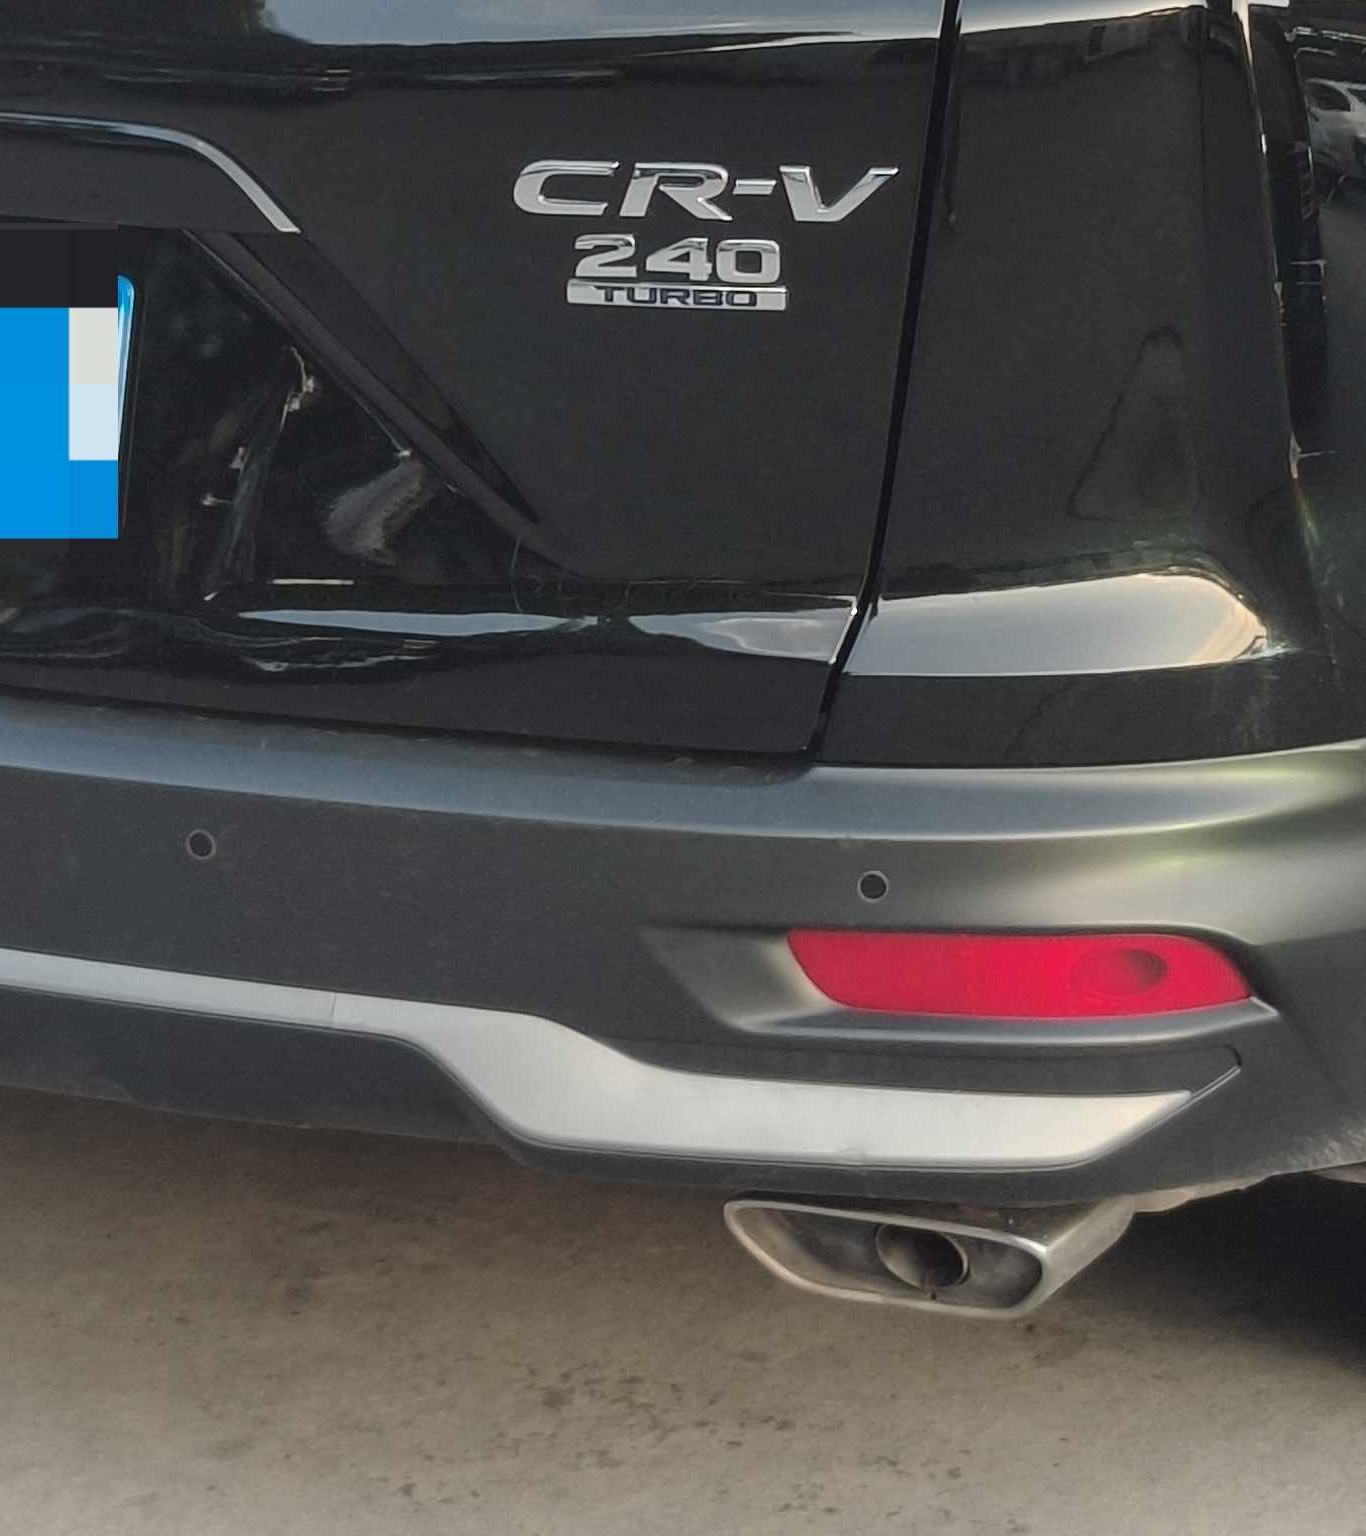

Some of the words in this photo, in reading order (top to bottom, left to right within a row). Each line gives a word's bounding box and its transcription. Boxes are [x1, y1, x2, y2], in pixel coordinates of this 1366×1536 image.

[513, 159, 899, 222] CR-V
[573, 233, 781, 283] 240
[597, 285, 758, 307] TURBO
